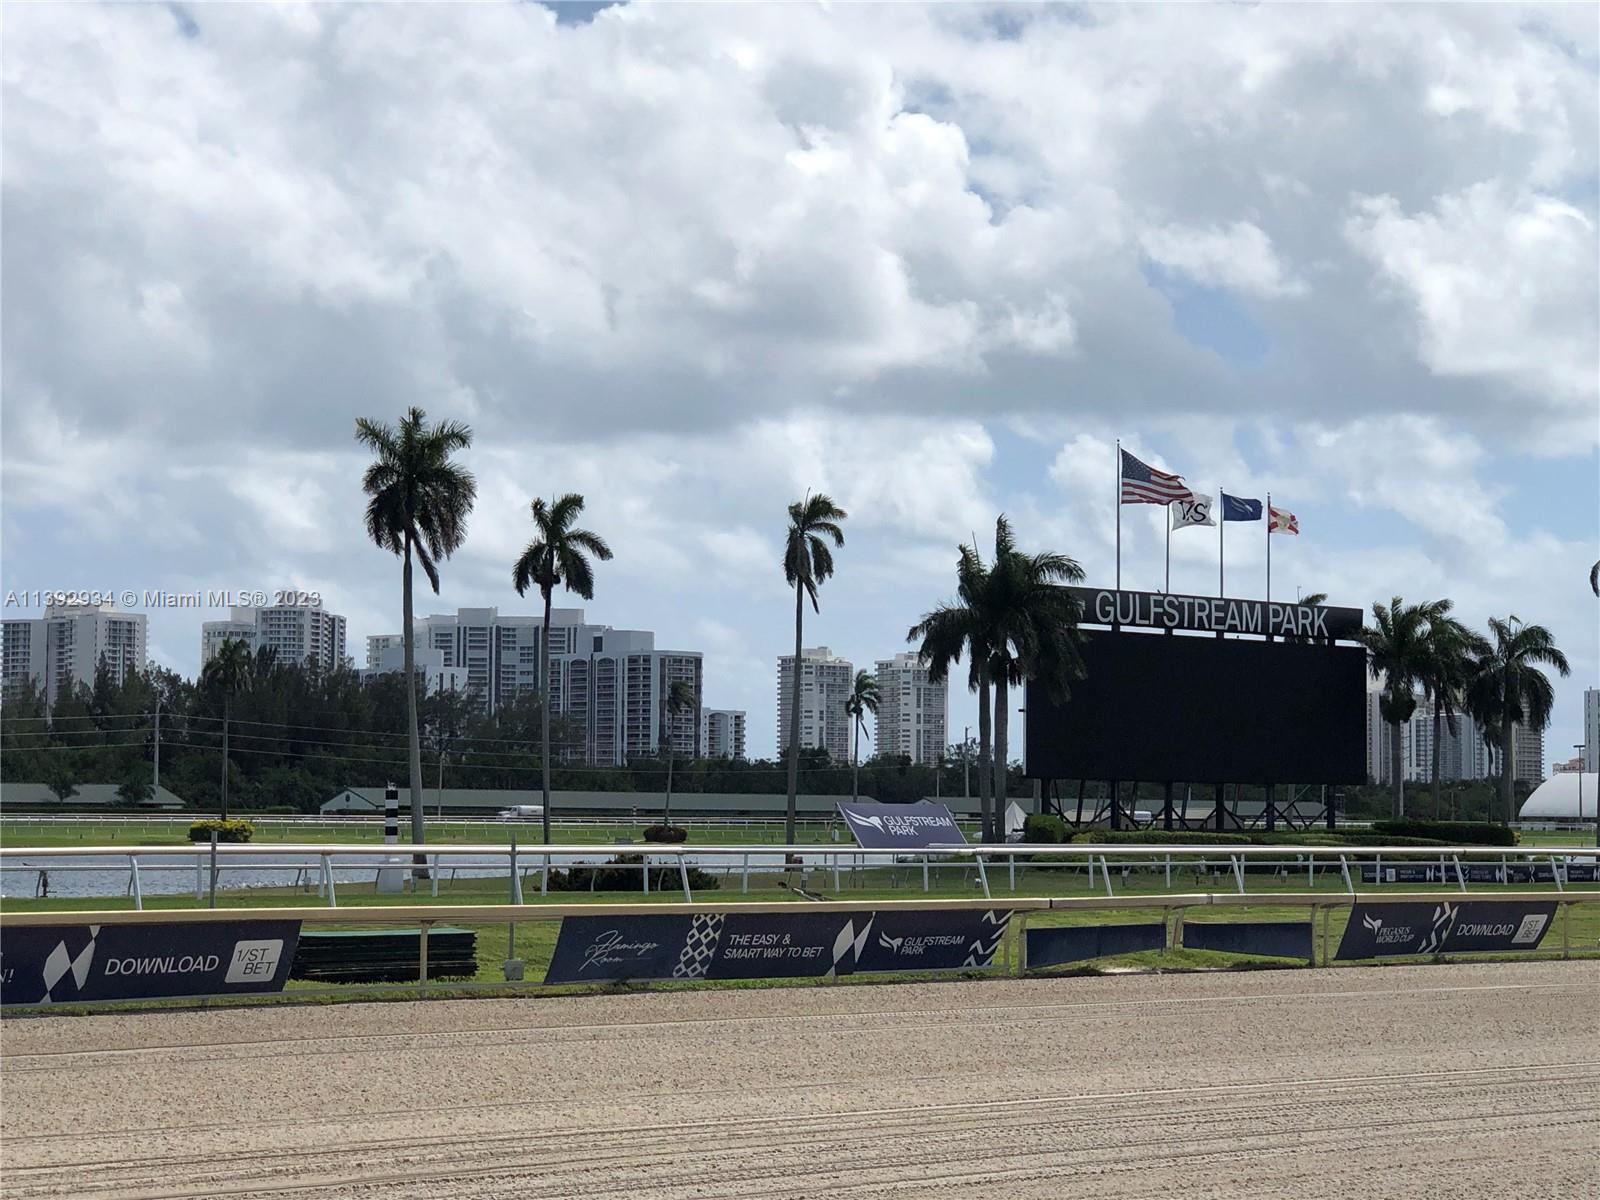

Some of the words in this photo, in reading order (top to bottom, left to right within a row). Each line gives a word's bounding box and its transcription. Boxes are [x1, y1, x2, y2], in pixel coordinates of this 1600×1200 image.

[1095, 591, 1262, 633] GULFSTREAM
[1268, 604, 1329, 637] PARK
[883, 815, 952, 828] GULFSTREAM
[888, 825, 918, 836] PARK
[1456, 924, 1515, 936] DOWNLOAD
[595, 930, 659, 956] Flamingo
[729, 934, 752, 946] THE
[752, 934, 781, 946] EASY
[782, 933, 792, 945] &
[904, 935, 965, 946] GULFSTREAM
[237, 948, 270, 963] 1/ST
[723, 948, 763, 959] SMART
[762, 947, 787, 959] WAY
[787, 946, 802, 958] TO
[801, 946, 825, 958] BET
[900, 945, 926, 955] PARK
[104, 955, 220, 976] DOWNLOAD
[243, 961, 275, 976] BET
